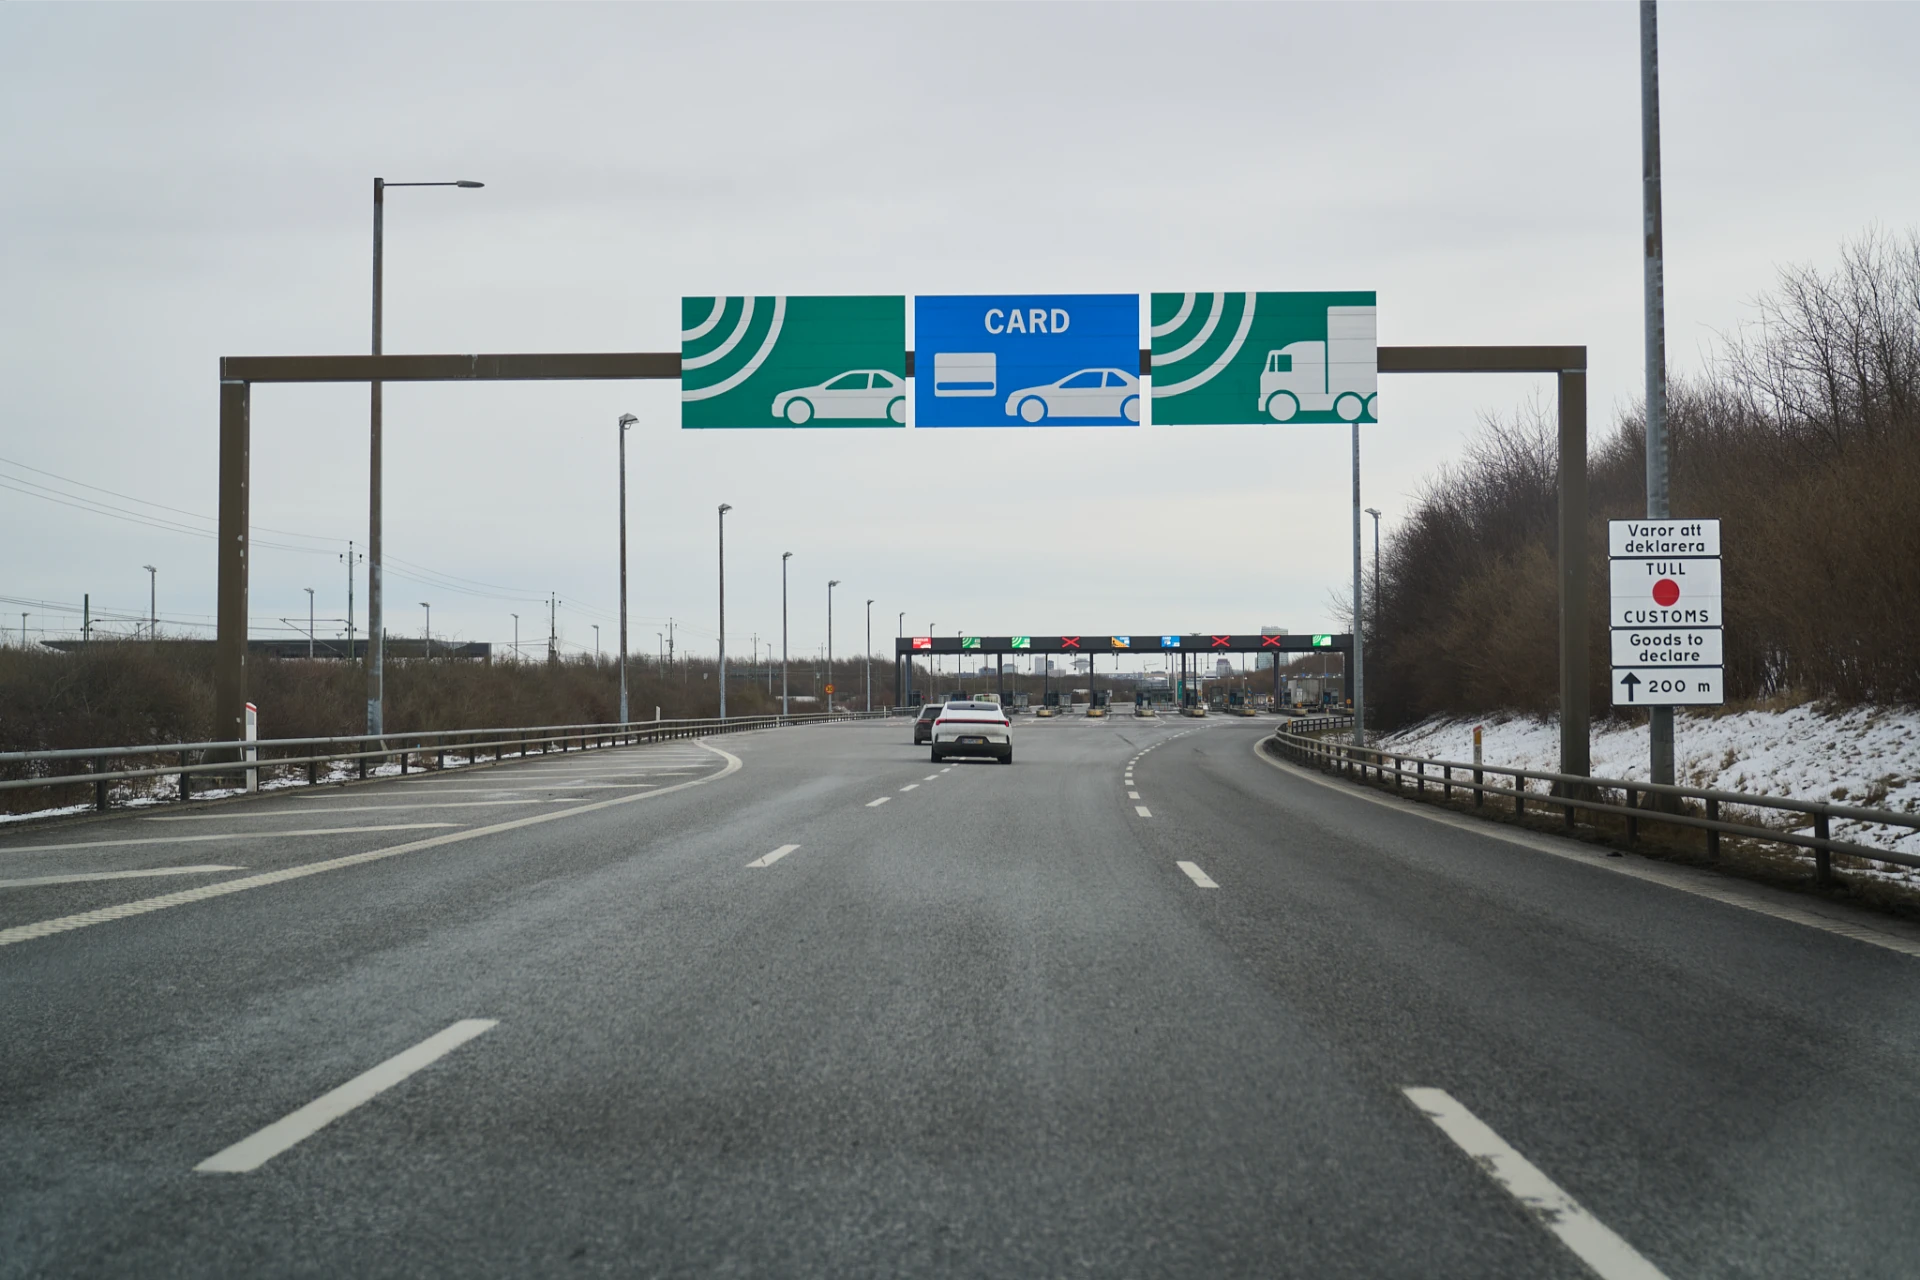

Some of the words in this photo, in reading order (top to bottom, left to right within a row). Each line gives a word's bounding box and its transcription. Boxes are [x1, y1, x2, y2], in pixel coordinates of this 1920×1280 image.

[984, 308, 1070, 334] CARD
[1628, 524, 1674, 536] Varor
[1681, 524, 1702, 536] att
[1626, 540, 1704, 552] deklarera
[1646, 562, 1686, 575] TULL
[1624, 610, 1708, 623] CUSTOMS
[1630, 634, 1682, 646] Goods
[1688, 634, 1703, 646] to
[1640, 650, 1700, 662] declare
[1649, 680, 1686, 692] 200
[1698, 682, 1710, 692] m
